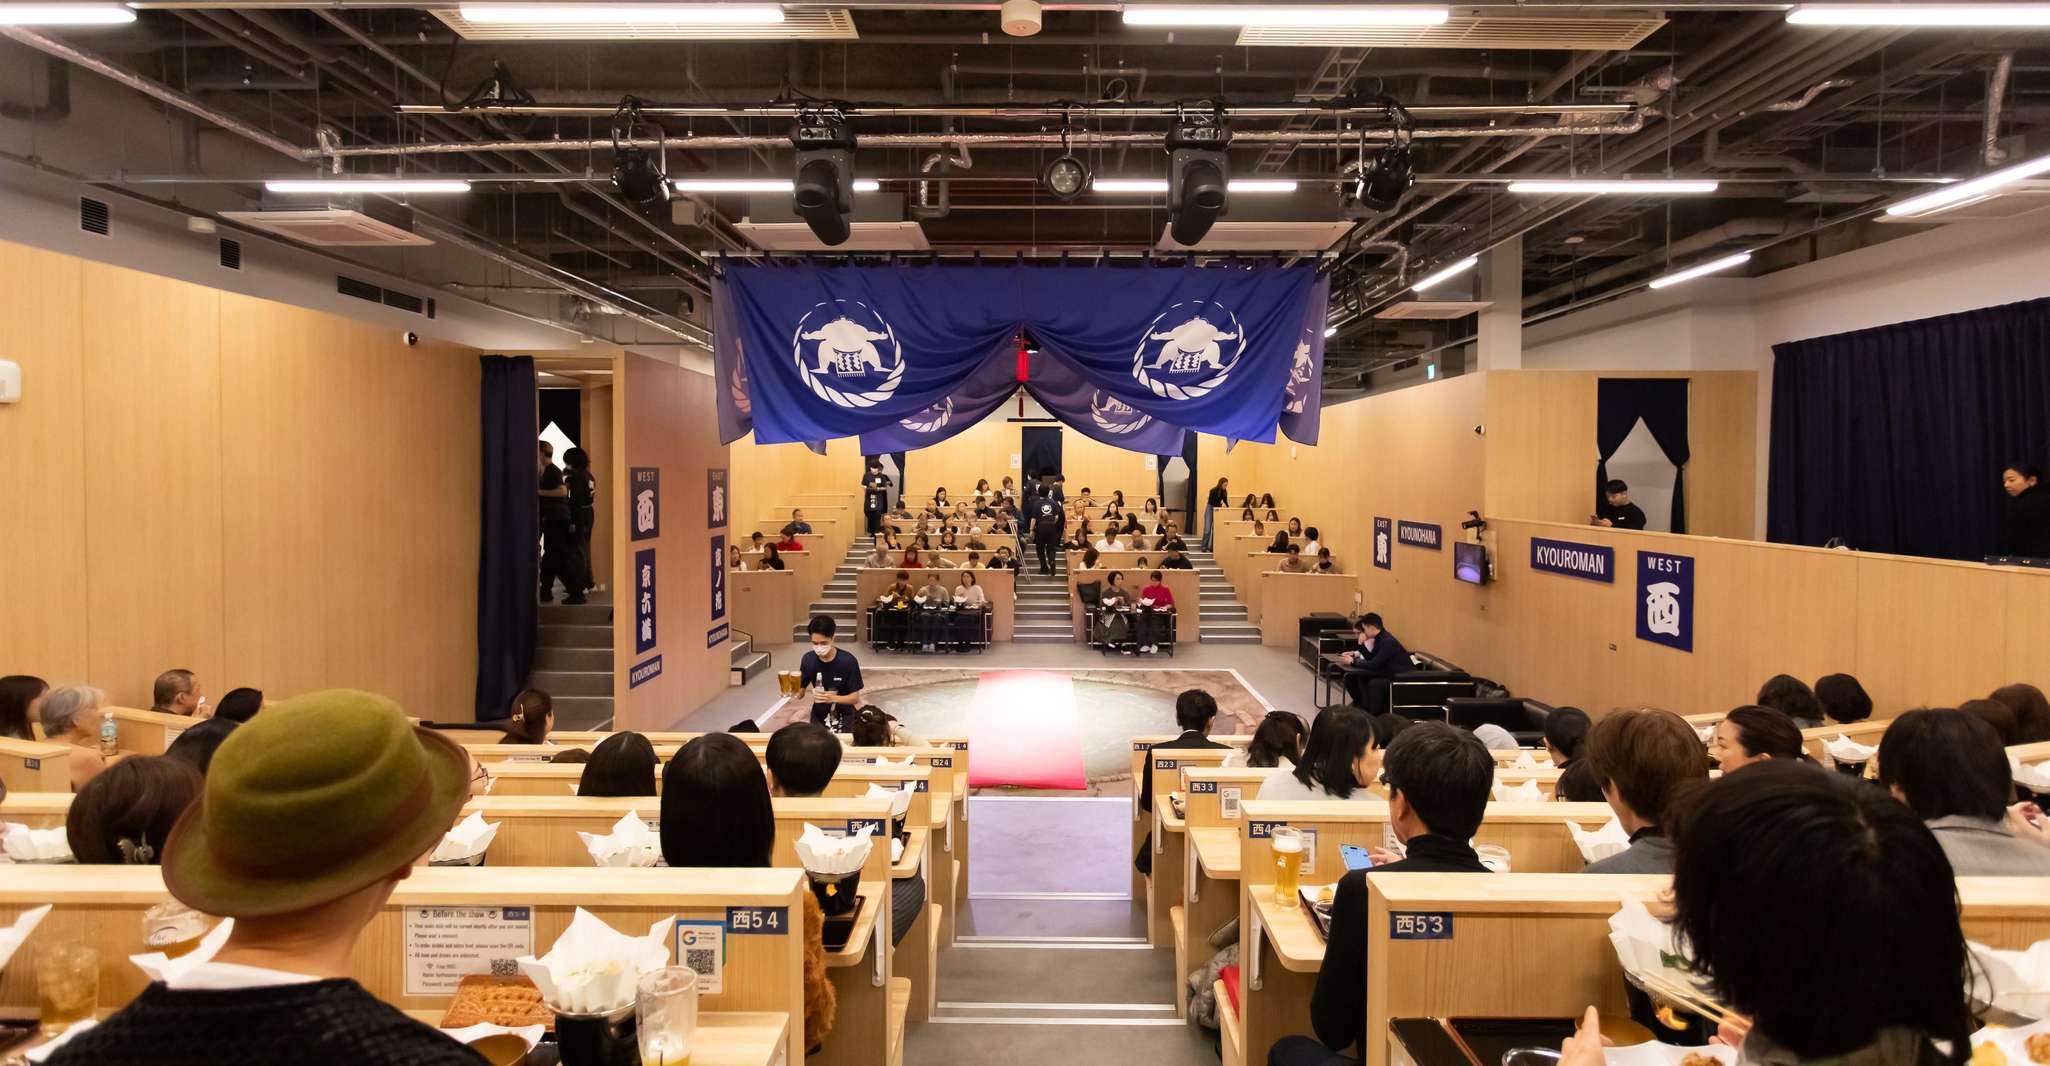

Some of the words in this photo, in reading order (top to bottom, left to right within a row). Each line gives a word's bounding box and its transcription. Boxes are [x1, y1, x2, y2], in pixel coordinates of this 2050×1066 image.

[637, 471, 655, 482] WEST
[637, 489, 655, 533] 西
[1400, 525, 1437, 545] KYOUNOHANA
[1536, 544, 1605, 576] KYOUROMAN
[1647, 556, 1682, 574] WEST
[1646, 581, 1681, 638] 西
[631, 660, 661, 684] KYOUROMAN
[1192, 783, 1214, 792] 西33
[433, 909, 454, 918] Before
[456, 909, 467, 918] the
[732, 910, 779, 929] 西54
[1395, 915, 1443, 934] 西53
